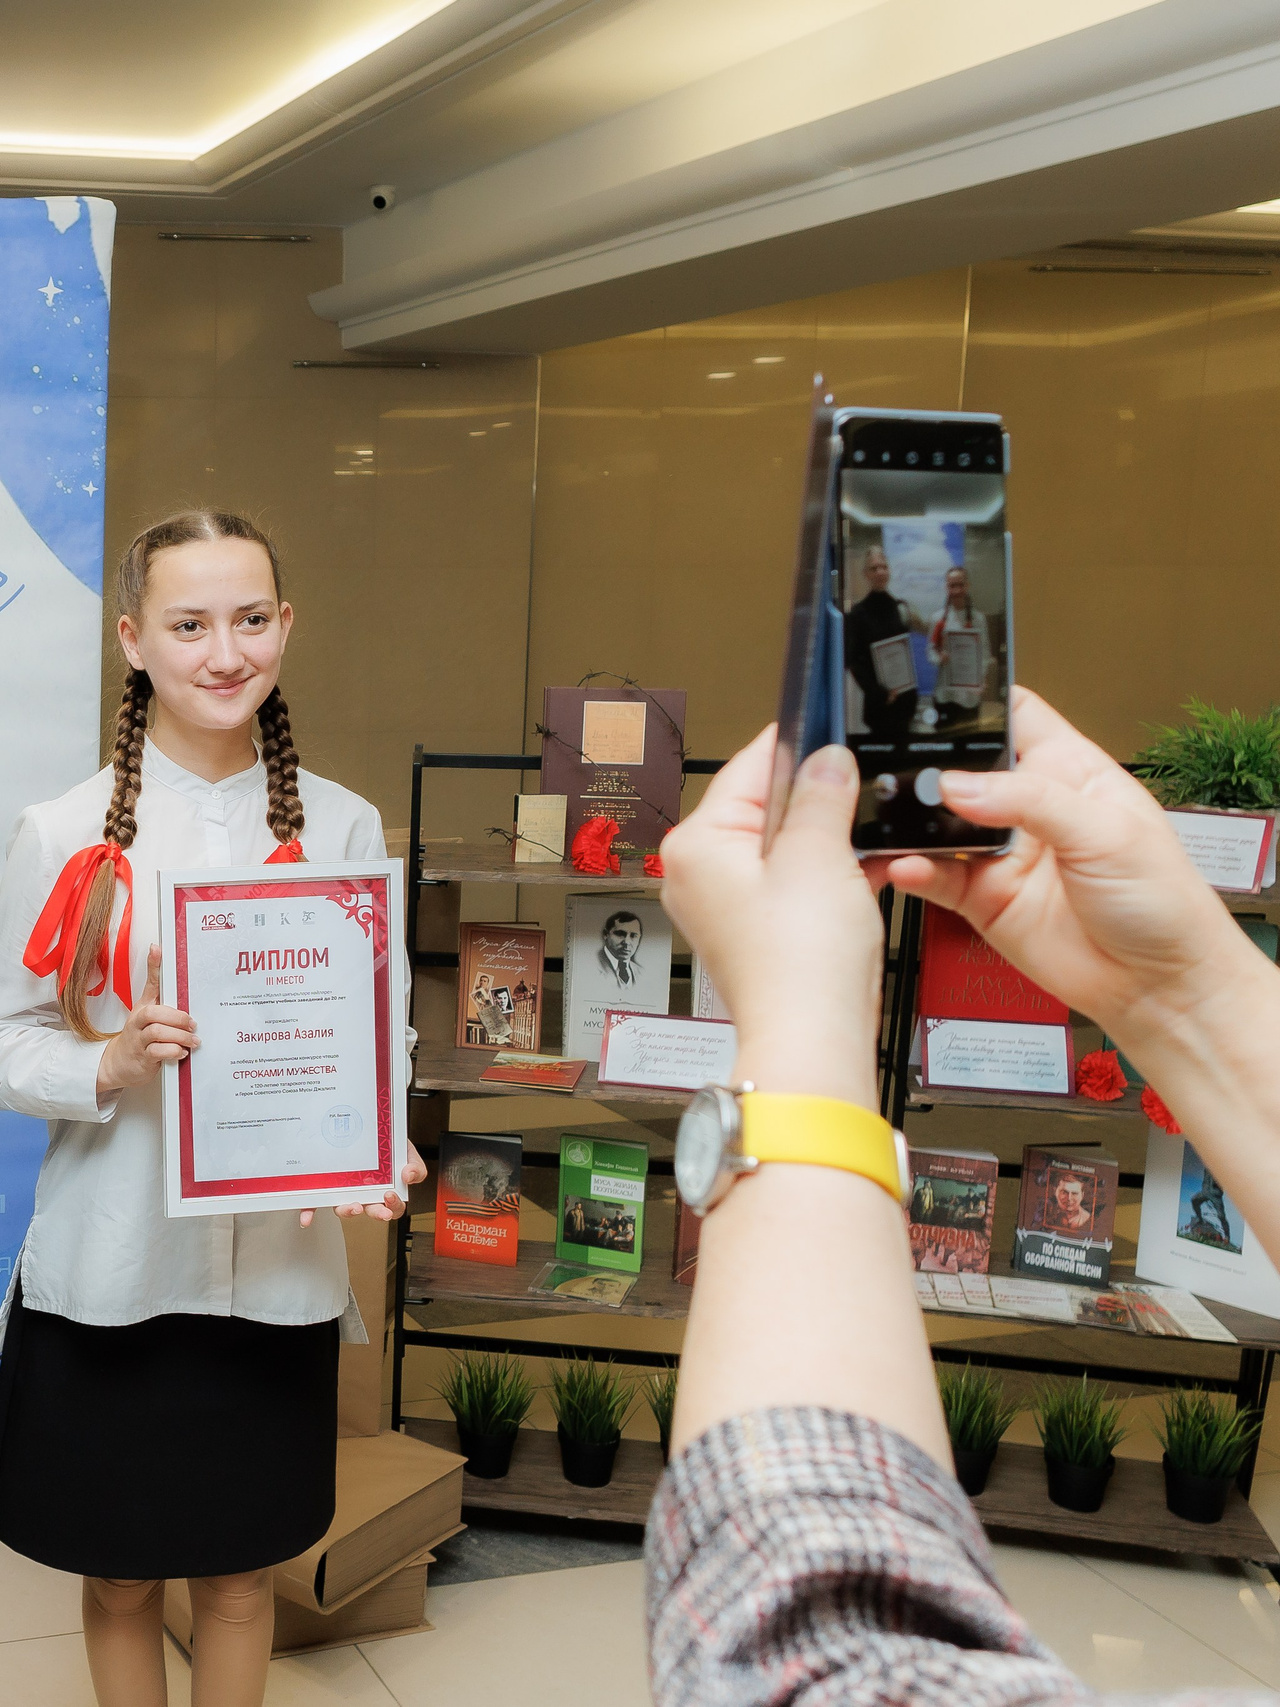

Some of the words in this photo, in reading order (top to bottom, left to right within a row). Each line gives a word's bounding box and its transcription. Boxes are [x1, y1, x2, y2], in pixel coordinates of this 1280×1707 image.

[201, 913, 227, 927] 120
[235, 947, 329, 975] ДИПЛОМ
[266, 976, 274, 986] III
[276, 975, 305, 986] МЕСТО
[966, 974, 1026, 993] МУСА
[583, 1020, 604, 1028] МУС
[236, 1030, 291, 1044] Закирова
[294, 1027, 334, 1040] Азалия
[233, 1068, 284, 1080] СТРОКАМИ
[286, 1065, 337, 1076] МУЖЕСТВА
[280, 1080, 307, 1088] татарского
[594, 1178, 612, 1187] МУСА
[593, 1186, 634, 1197] ПОЭТИКАСЫ
[445, 1218, 508, 1238] Каһарман
[453, 1232, 498, 1248] каләме
[1042, 1242, 1054, 1256] ПО
[1054, 1244, 1087, 1262] СЛЕДАМ
[1024, 1250, 1075, 1276] ОБОРВАННОЙ
[1075, 1260, 1102, 1279] ПЕСНИ
